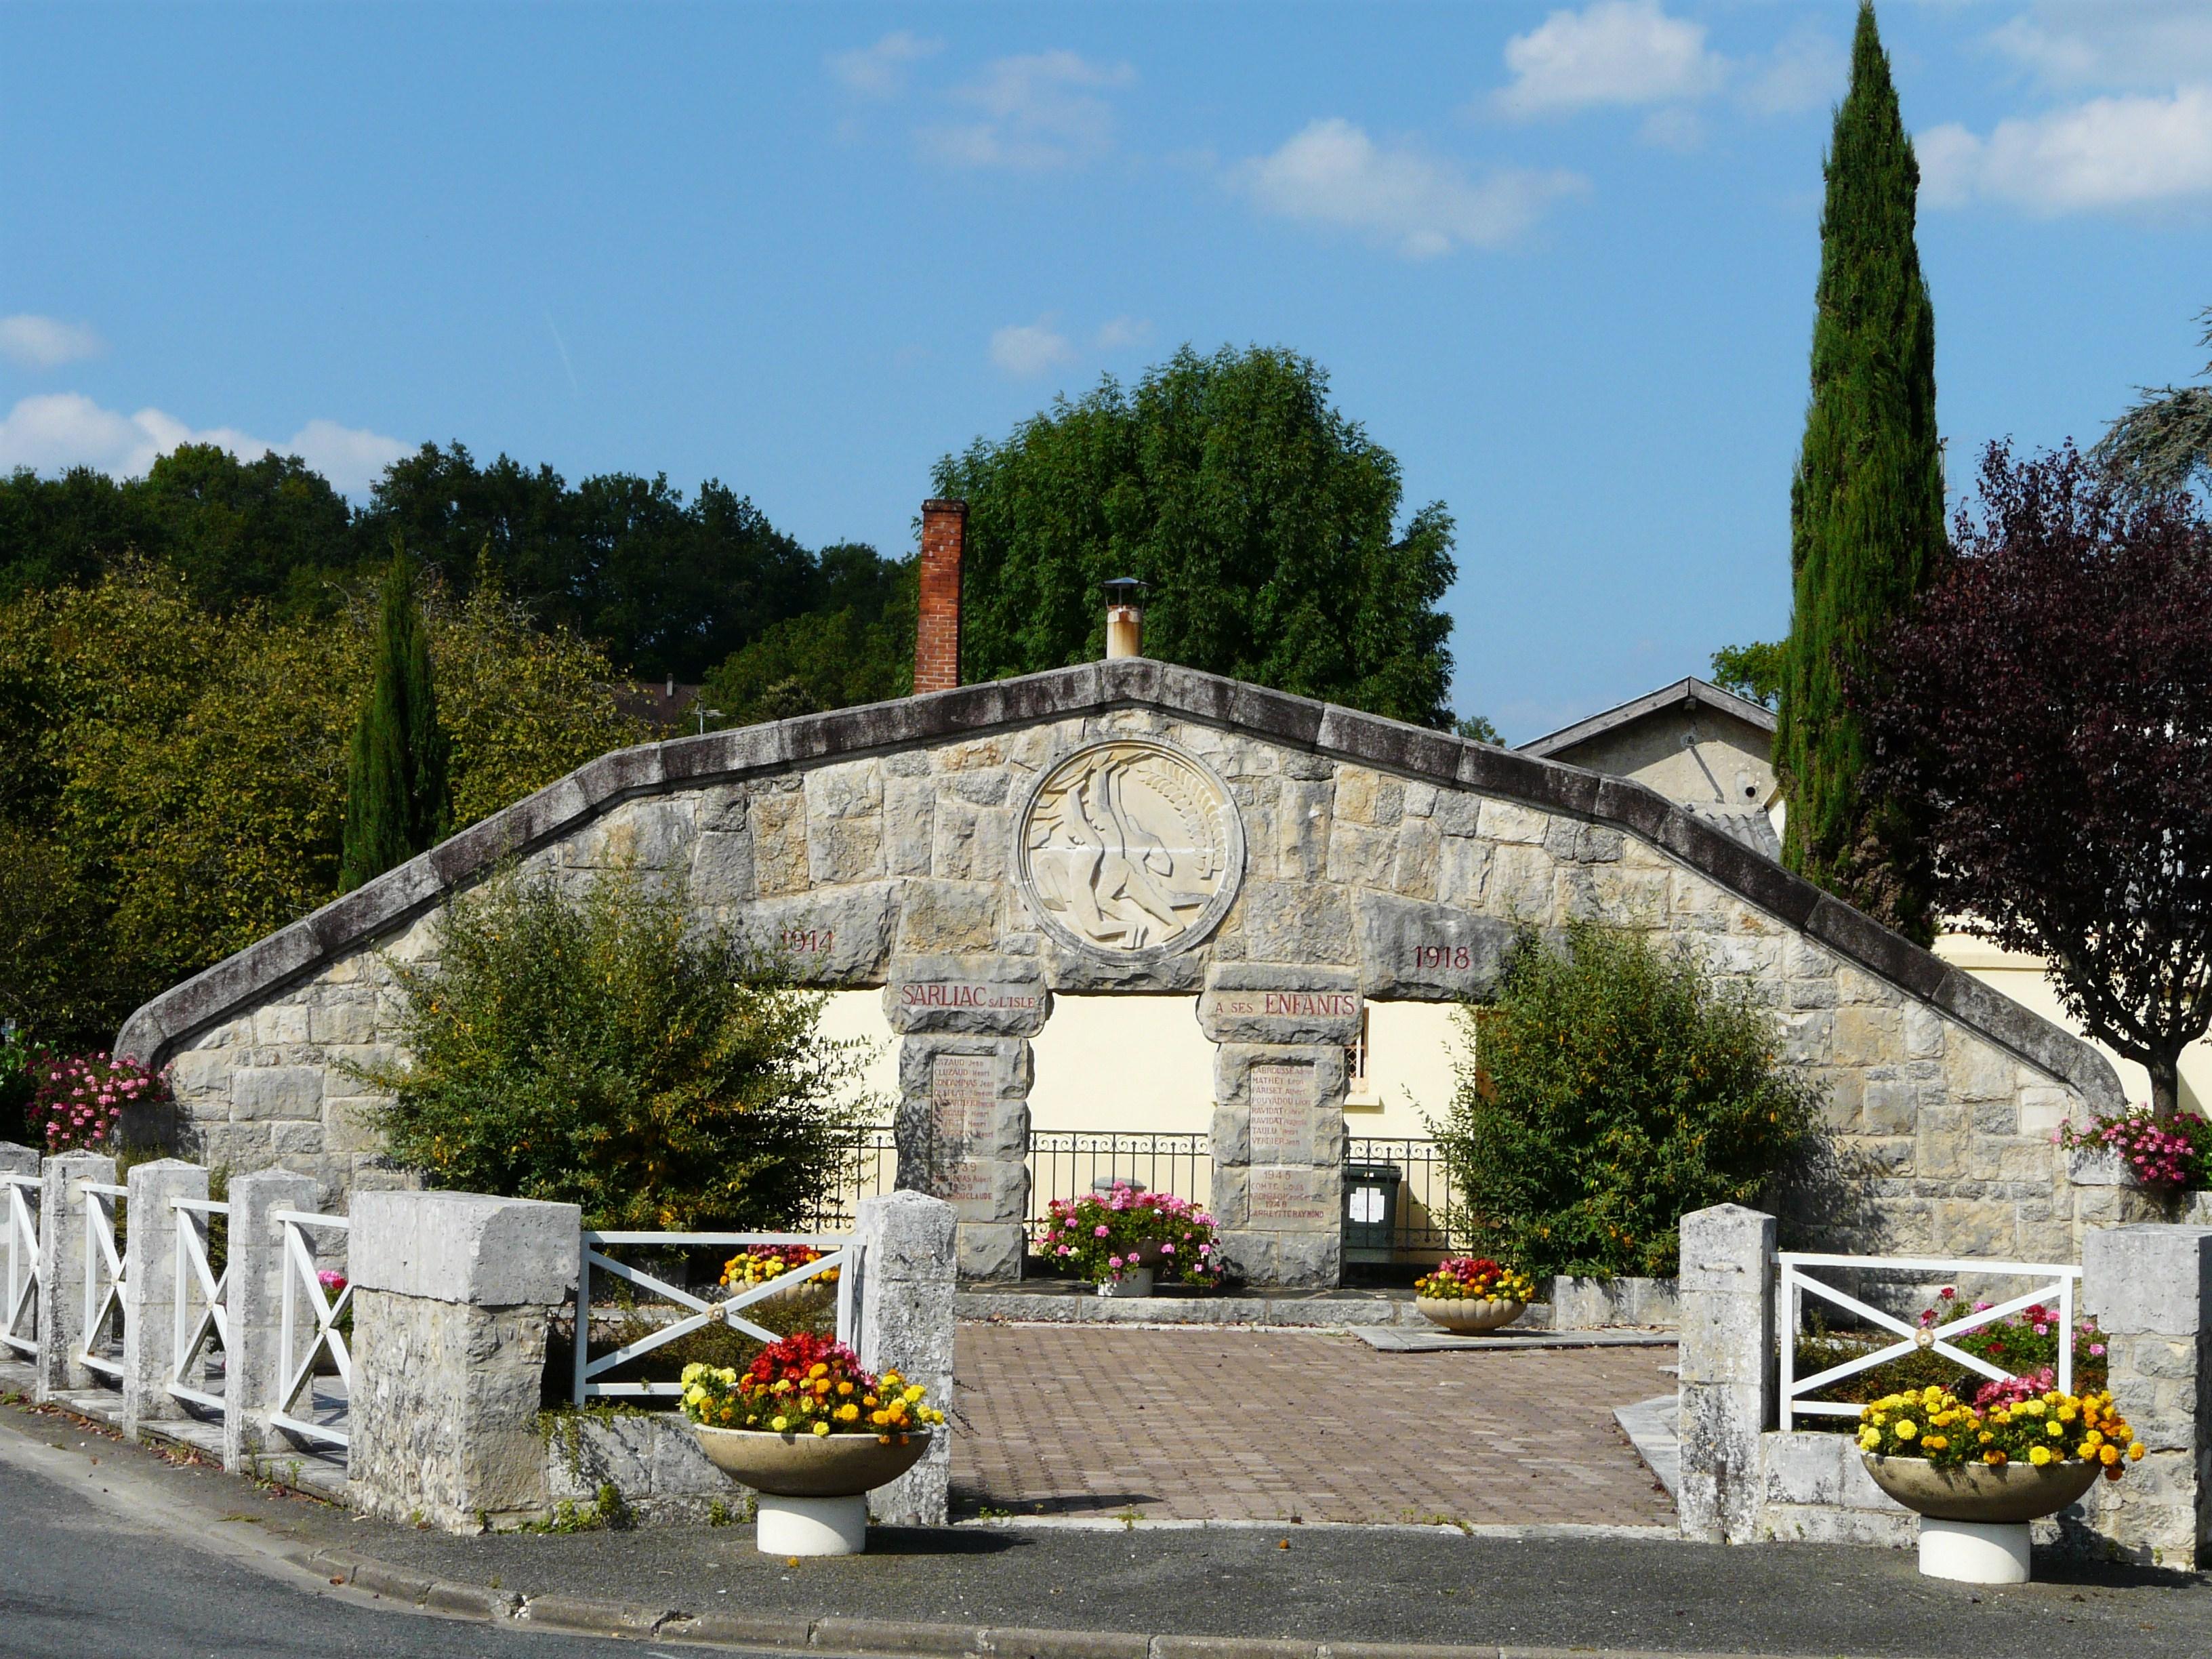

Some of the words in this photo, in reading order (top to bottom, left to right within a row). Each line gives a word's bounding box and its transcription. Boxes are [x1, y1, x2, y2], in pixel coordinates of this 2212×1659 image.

[781, 928, 834, 953] 1914
[1414, 945, 1471, 970] 1918
[901, 985, 987, 1006] SARLIAC
[1215, 1002, 1224, 1013] A
[1231, 1002, 1254, 1013] SES
[1265, 993, 1355, 1015] ENFANTS
[1251, 1117, 1283, 1125] RAVIDAT
[1263, 1170, 1291, 1180] 1945
